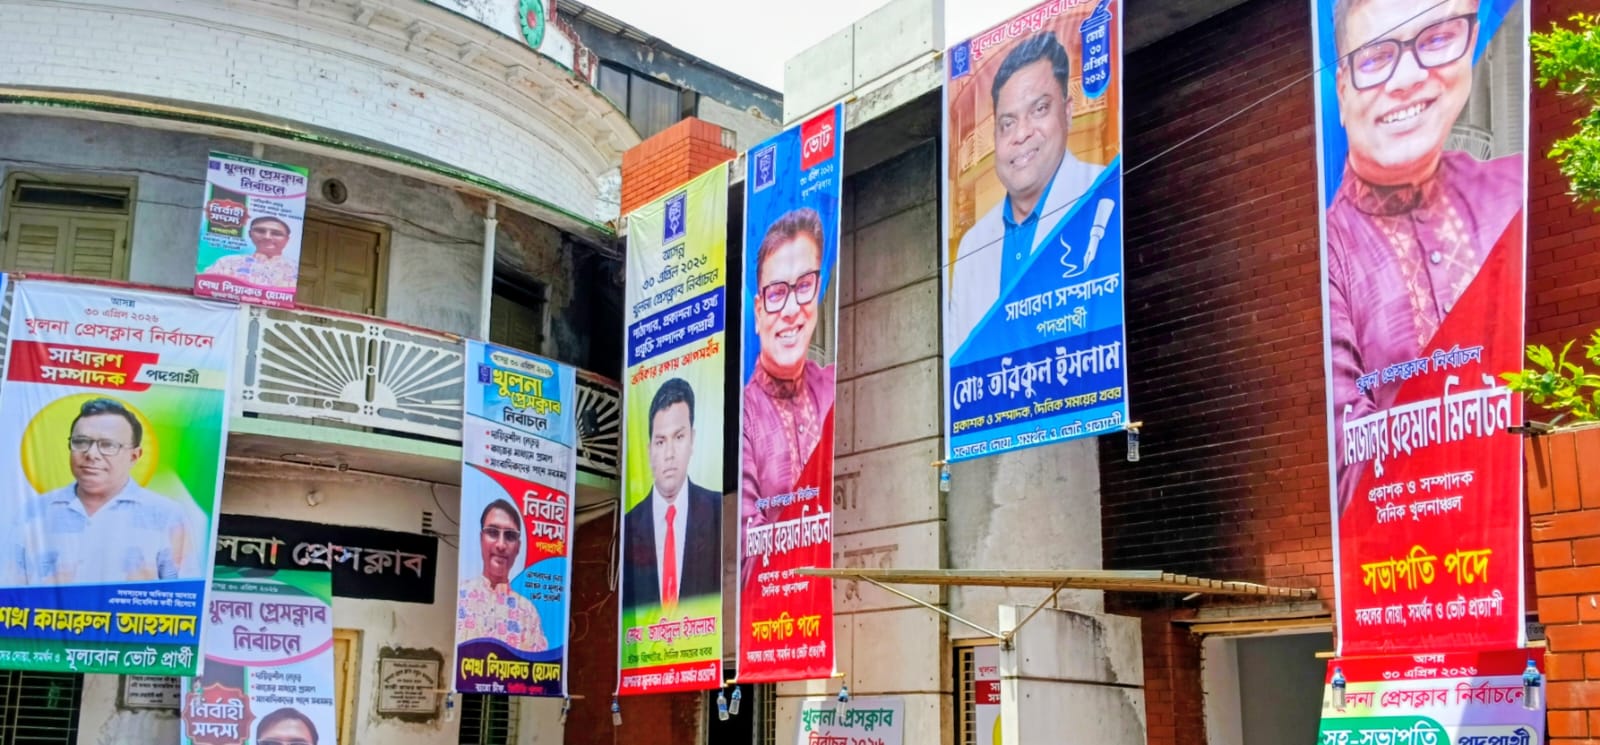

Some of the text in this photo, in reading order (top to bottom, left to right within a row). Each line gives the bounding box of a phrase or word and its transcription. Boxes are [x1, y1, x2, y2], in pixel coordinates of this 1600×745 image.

[971, 25, 1006, 61] খুলনা
[1086, 25, 1106, 43] ভোট
[1090, 45, 1102, 55] ৩০
[1083, 54, 1108, 72] এপ্রিল
[803, 125, 832, 159] ভোট
[223, 162, 304, 185] খুলনা প্রেসক্লাব
[240, 177, 285, 195] নির্বাচনে
[209, 202, 244, 217] নির্বাহী
[211, 212, 241, 225] সদস্য
[662, 242, 685, 261] আসন্ন
[198, 279, 220, 290] শেখ
[642, 255, 708, 290] ৩০ এপ্রিল ২০২৬
[686, 269, 720, 293] নির্বাচনে
[110, 297, 136, 309] আসন্ন
[693, 302, 701, 315] ও
[702, 293, 720, 311] তথ্য
[1004, 273, 1120, 321] সাধারণ সম্পাদক
[83, 307, 160, 323] ৩০ এপ্রিল ২০২৬
[1036, 307, 1088, 337] পদপ্রার্থী
[25, 318, 214, 348] খুলনা প্রেসক্লাব নির্বাচনে
[48, 349, 124, 369] সাধারণ
[1381, 359, 1428, 383] প্রেসক্লাব
[1431, 345, 1484, 372] নির্বাচন
[40, 365, 200, 387] সম্পাদক পদপ্রার্থী
[492, 370, 544, 397] খুলনা
[953, 342, 1121, 410] মোঃ তরিকুল ইসলাম
[511, 393, 562, 416] প্রেসক্লাব
[953, 416, 985, 434] প্রকাশক
[986, 414, 994, 425] ও
[1034, 396, 1063, 415] দৈনিক
[1064, 392, 1097, 409] সময়ের
[503, 407, 548, 431] নির্বাচনে
[1050, 430, 1058, 441] ও
[1061, 421, 1082, 437] ভোট
[1342, 373, 1513, 478] মিজানুর রহমান মিলটন
[1367, 471, 1475, 503] প্রকাশক ও সম্পাদক
[522, 490, 567, 523] নির্বাহী
[1376, 496, 1464, 524] দৈনিক খুলনাঞ্চল
[531, 521, 566, 542] সদস্য
[746, 505, 831, 568] মিজানুর রহমান মিলটন
[291, 542, 427, 578] প্রেসক্লাব
[1361, 546, 1492, 594] সভাপতি পদে
[209, 601, 253, 624] খুলনা
[259, 603, 327, 627] প্রেসক্লাব
[1355, 607, 1382, 625] সকলের
[1408, 597, 1433, 621] সমর্থন
[1435, 603, 1443, 618] ও
[1447, 598, 1466, 620] ভোট
[1468, 590, 1504, 618] প্রত্যাশী
[33, 609, 111, 635] কামরুল
[116, 614, 197, 636] আহসান
[682, 618, 716, 639] ইসলাম
[751, 612, 822, 642] সভাপতি পদে
[233, 626, 301, 655] নির্বাচনে
[64, 649, 121, 671] মূল্যবান
[123, 647, 157, 667] ভোট
[160, 647, 194, 668] প্রার্থী
[461, 658, 484, 680] শেখ
[486, 653, 530, 681] লিয়াকত
[1382, 666, 1478, 680] ৩০ এপ্রিল ২০২৬
[1381, 688, 1449, 710] প্রেসক্লাব
[1455, 681, 1526, 706] নির্বাচনে
[190, 698, 243, 721] নির্বাহী
[802, 709, 895, 732] খুলনা প্রেসক্লাব
[192, 722, 238, 739] সদস্য
[1322, 722, 1441, 745] সহ-সভাপতি
